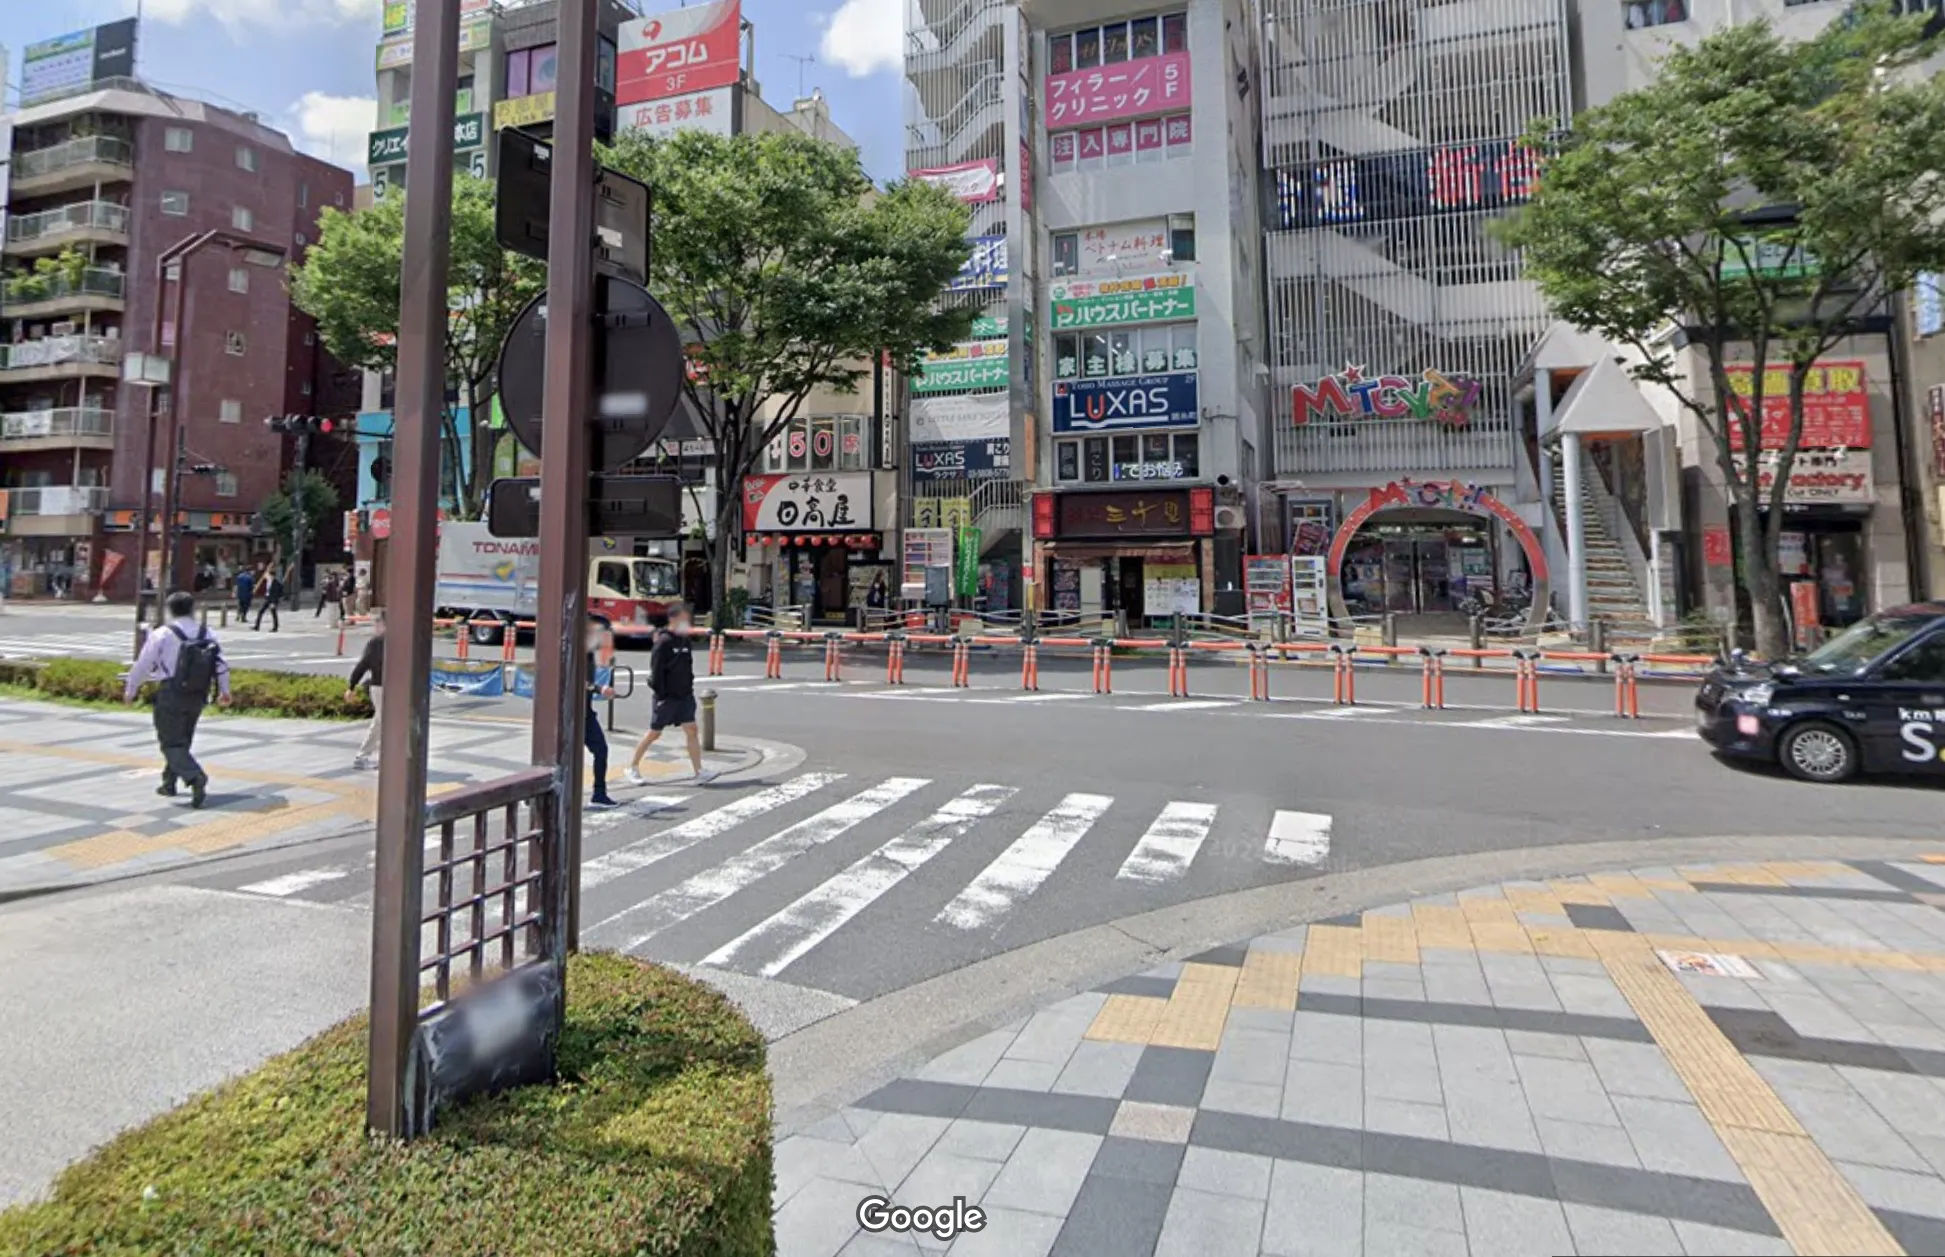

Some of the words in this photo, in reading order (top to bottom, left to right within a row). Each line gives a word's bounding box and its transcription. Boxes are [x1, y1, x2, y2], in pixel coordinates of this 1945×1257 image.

[645, 41, 708, 74] アコム
[667, 73, 686, 91] 3F
[636, 96, 713, 127] 広告募集
[1051, 88, 1150, 120] クリニック
[1056, 121, 1189, 156] 注入専門院
[1085, 234, 1165, 254] ベトナム料理
[1076, 298, 1189, 325] ハウスパートナー
[1070, 388, 1169, 420] LUXAS
[916, 450, 965, 470] LUXAS
[788, 476, 837, 493] 中華食堂
[1791, 472, 1865, 491] actory
[777, 494, 855, 527] 日高屋
